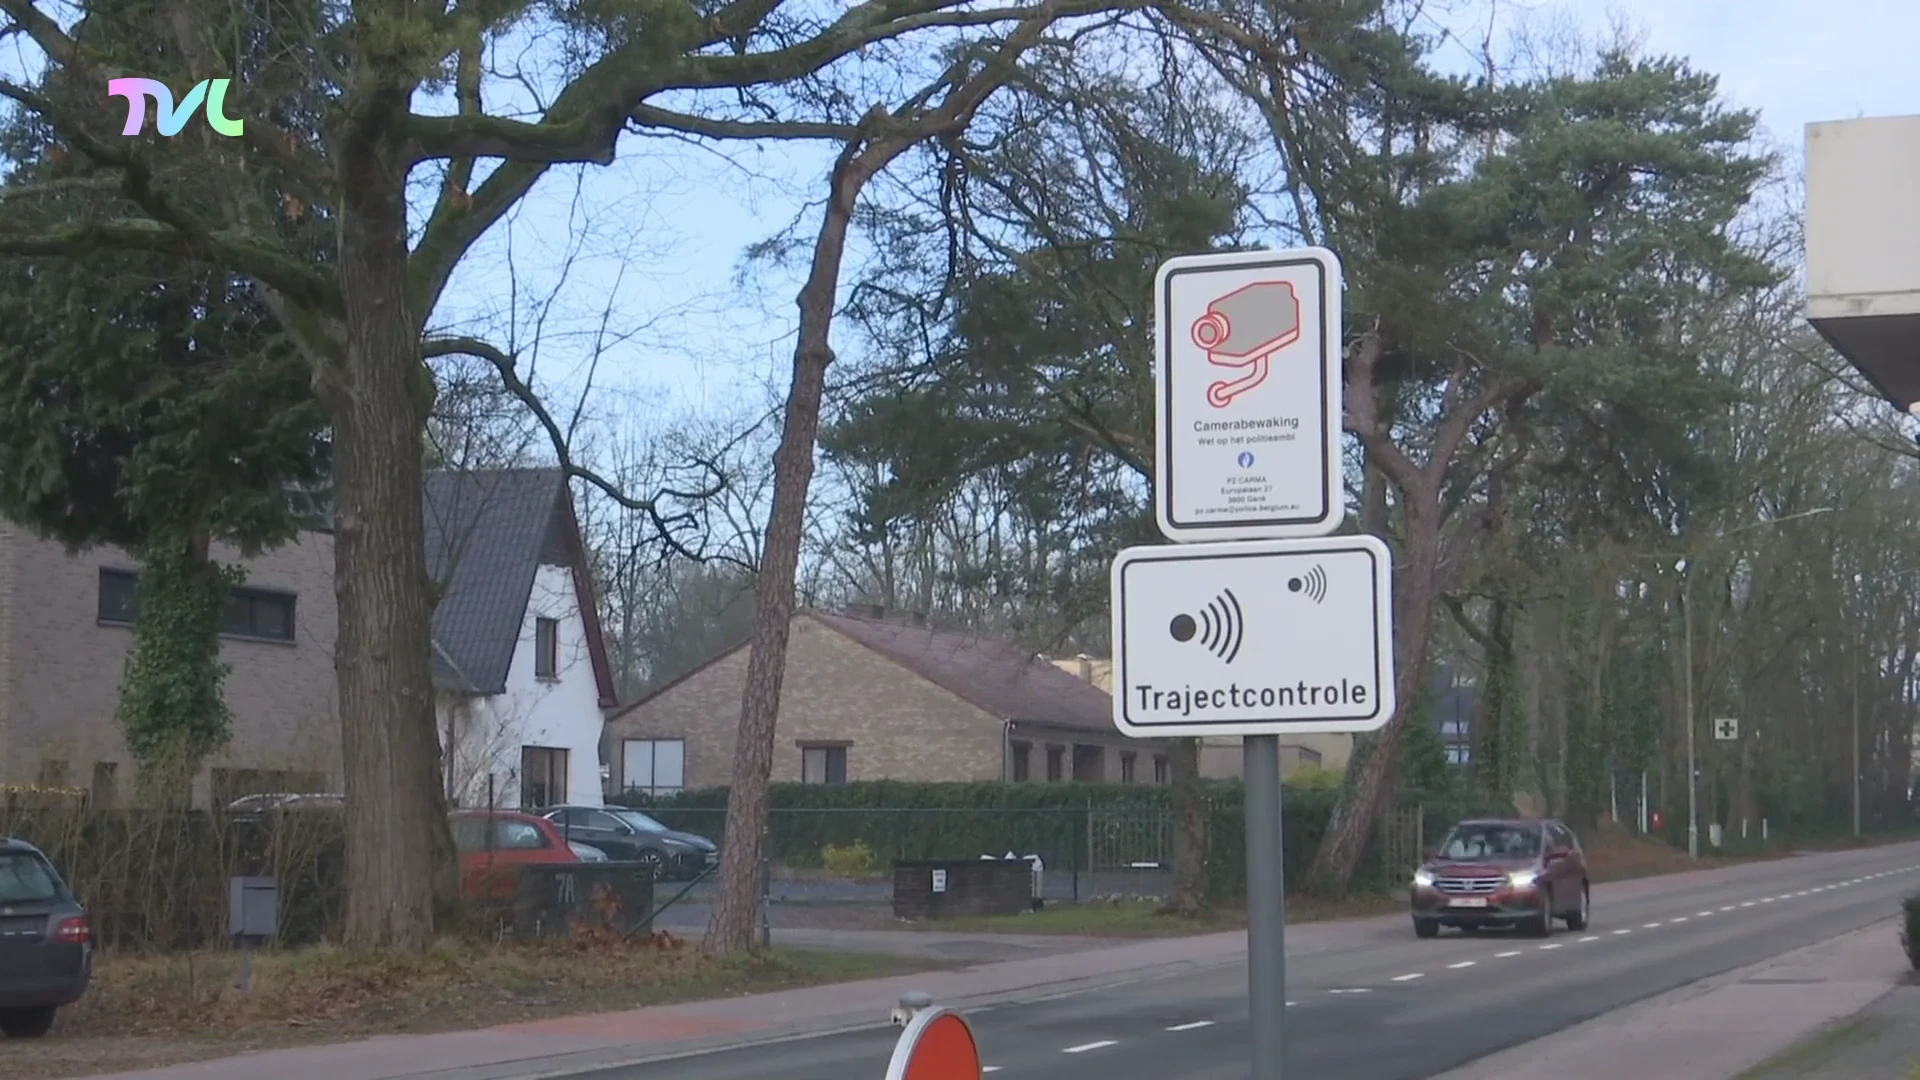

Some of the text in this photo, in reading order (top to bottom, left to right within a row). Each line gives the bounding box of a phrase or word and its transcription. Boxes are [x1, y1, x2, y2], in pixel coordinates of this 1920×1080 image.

[1193, 416, 1300, 432] Camerabewaking
[1216, 438, 1228, 446] op
[1230, 436, 1244, 444] het
[1238, 476, 1267, 484] CARMA
[1135, 678, 1366, 716] Trajectcontrole
